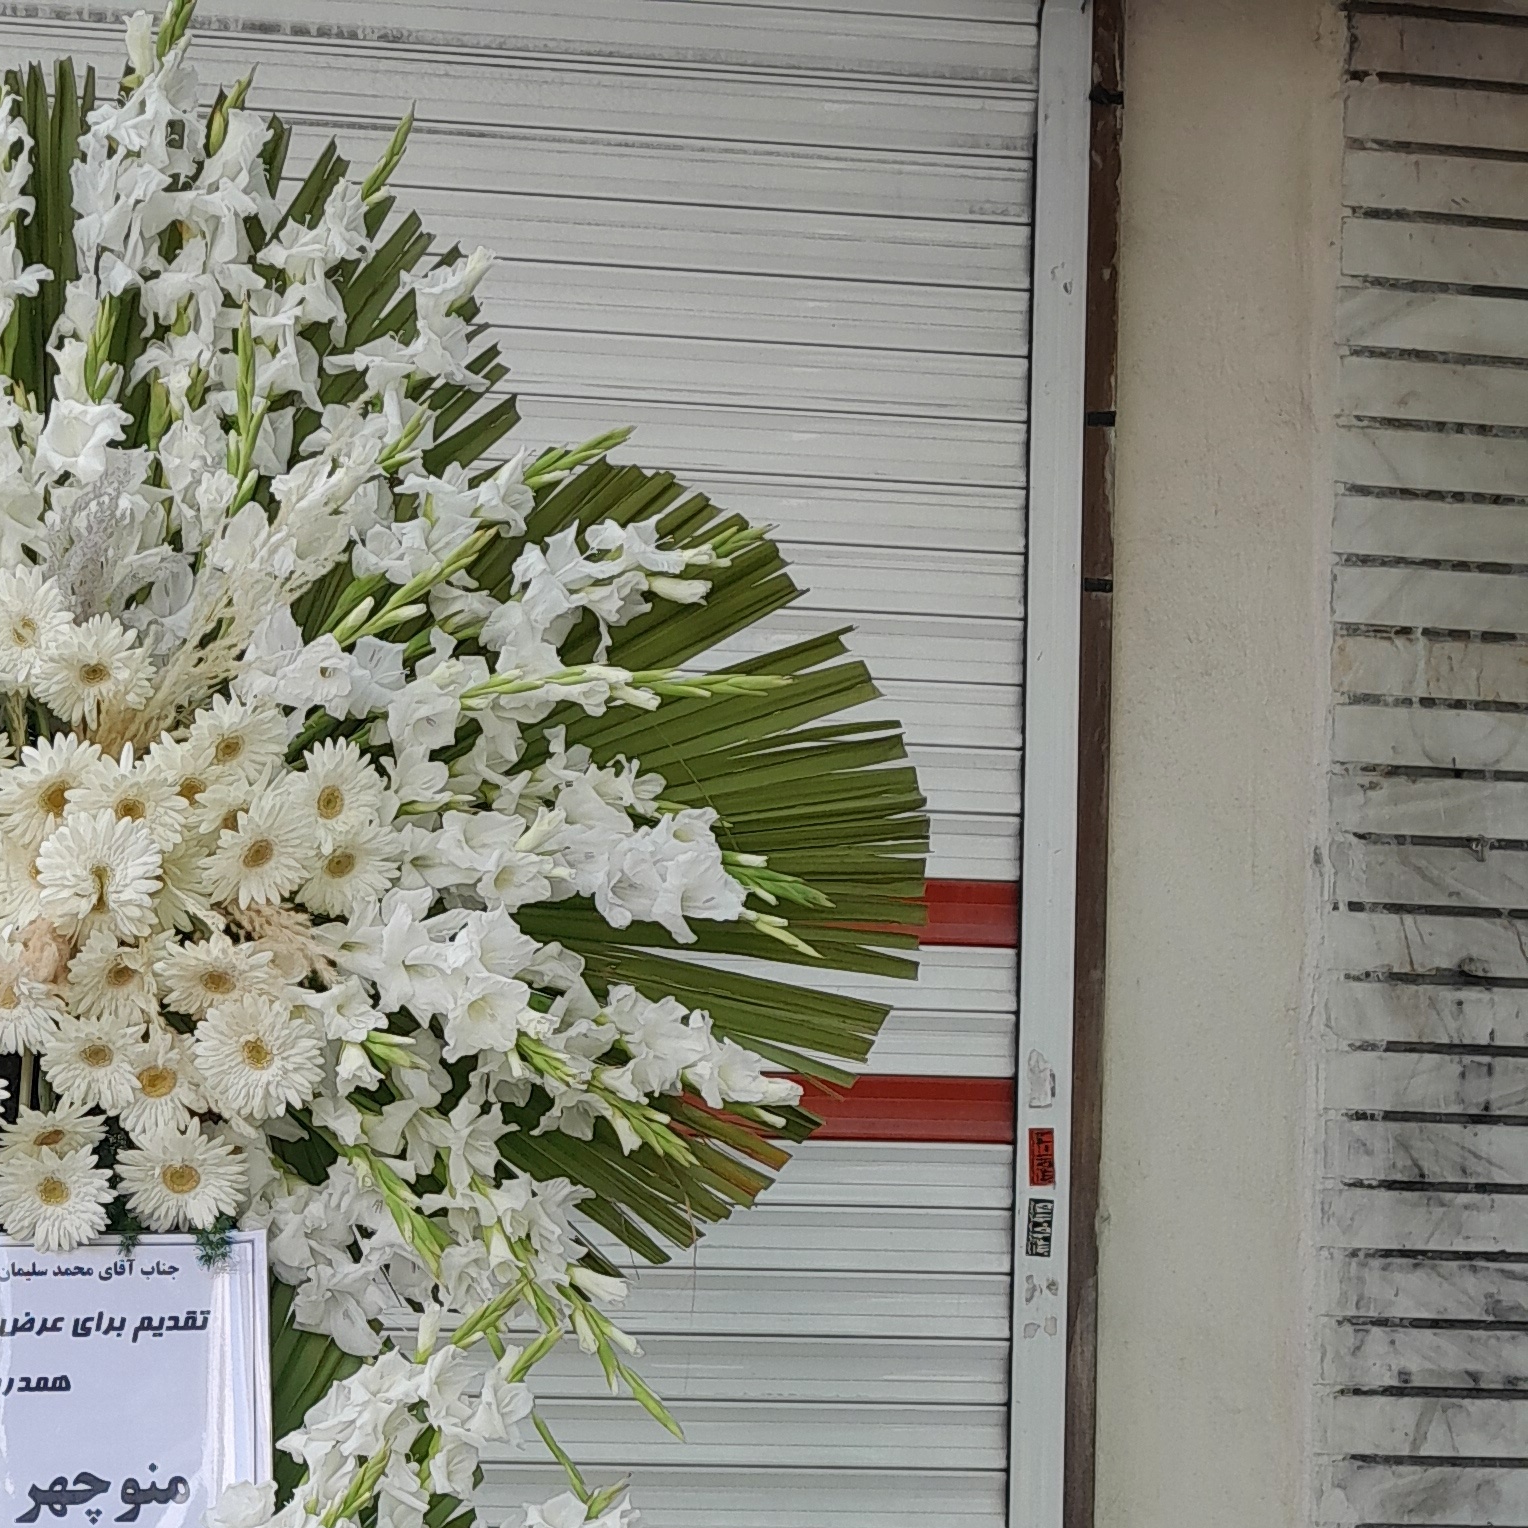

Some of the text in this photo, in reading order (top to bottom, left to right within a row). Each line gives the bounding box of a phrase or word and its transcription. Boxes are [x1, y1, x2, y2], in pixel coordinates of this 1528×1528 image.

[52, 1265, 94, 1277] محمد
[98, 1258, 136, 1282] آقای
[140, 1260, 180, 1281] جناب
[71, 1311, 127, 1338] برای
[131, 1310, 211, 1344] تقدیم
